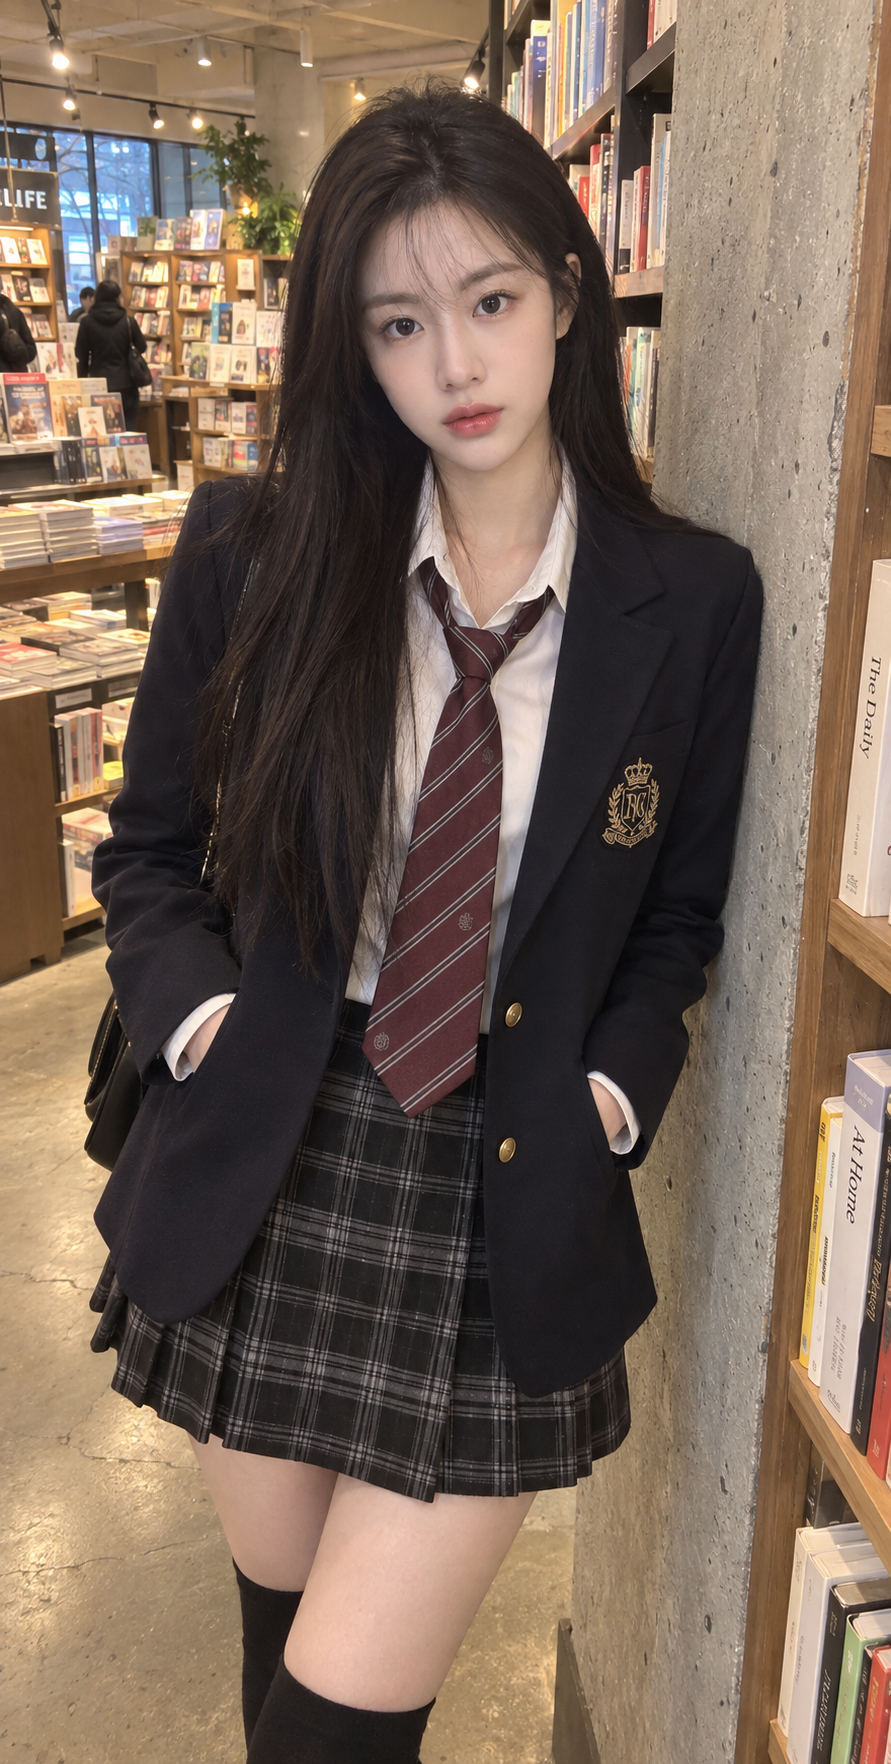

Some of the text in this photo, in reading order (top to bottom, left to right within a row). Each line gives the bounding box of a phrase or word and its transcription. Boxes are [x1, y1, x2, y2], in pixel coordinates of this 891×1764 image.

[0, 188, 47, 209] LIFE
[859, 657, 882, 759] The Daily
[852, 1125, 865, 1156] At
[846, 1157, 863, 1224] Home
